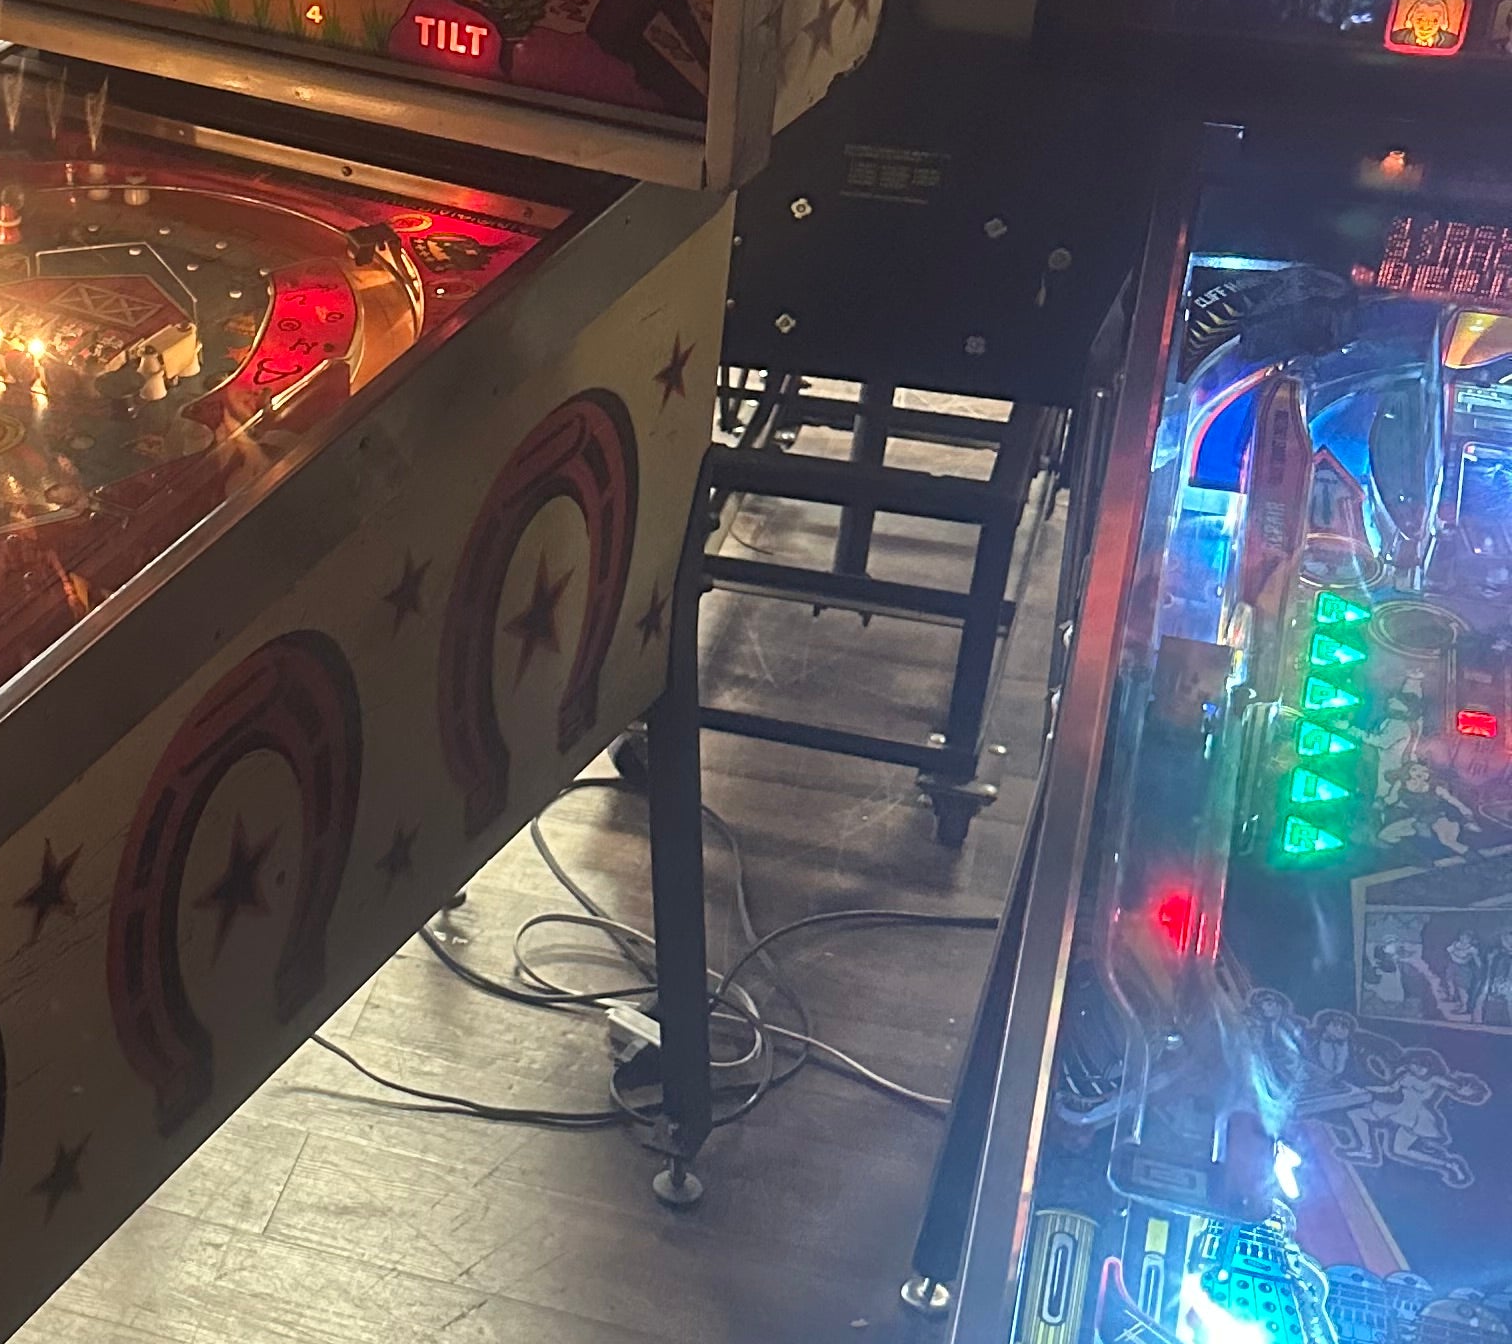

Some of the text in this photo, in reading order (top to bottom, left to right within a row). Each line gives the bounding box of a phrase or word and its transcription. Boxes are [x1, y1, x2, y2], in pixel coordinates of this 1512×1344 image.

[306, 3, 325, 25] 4
[414, 14, 489, 57] TILT
[1194, 285, 1228, 310] CLIFF
